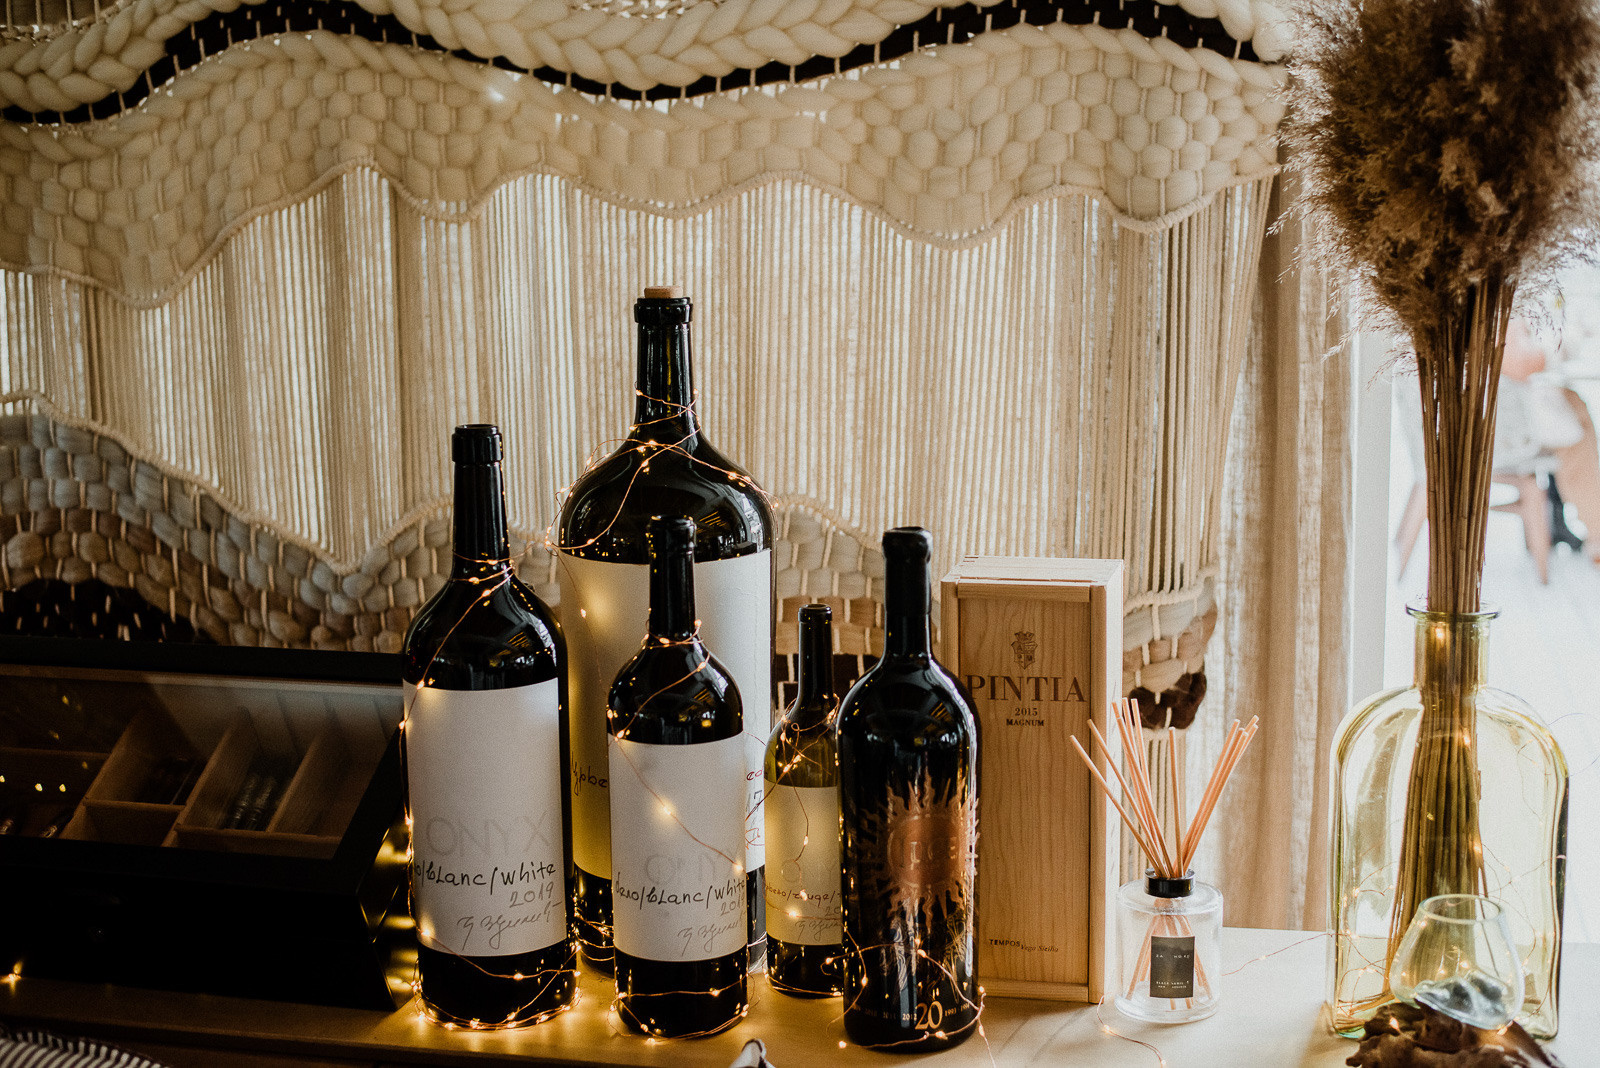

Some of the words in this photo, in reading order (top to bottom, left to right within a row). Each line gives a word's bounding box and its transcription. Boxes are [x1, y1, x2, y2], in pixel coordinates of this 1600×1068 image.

[965, 675, 1087, 702] PINTIA
[1006, 718, 1044, 727] MAGNUM
[1015, 707, 1038, 717] 2015
[426, 810, 551, 857] ONYX
[510, 881, 554, 908] 2019
[989, 938, 1020, 947] TEMPOS
[915, 1001, 943, 1030] 20
